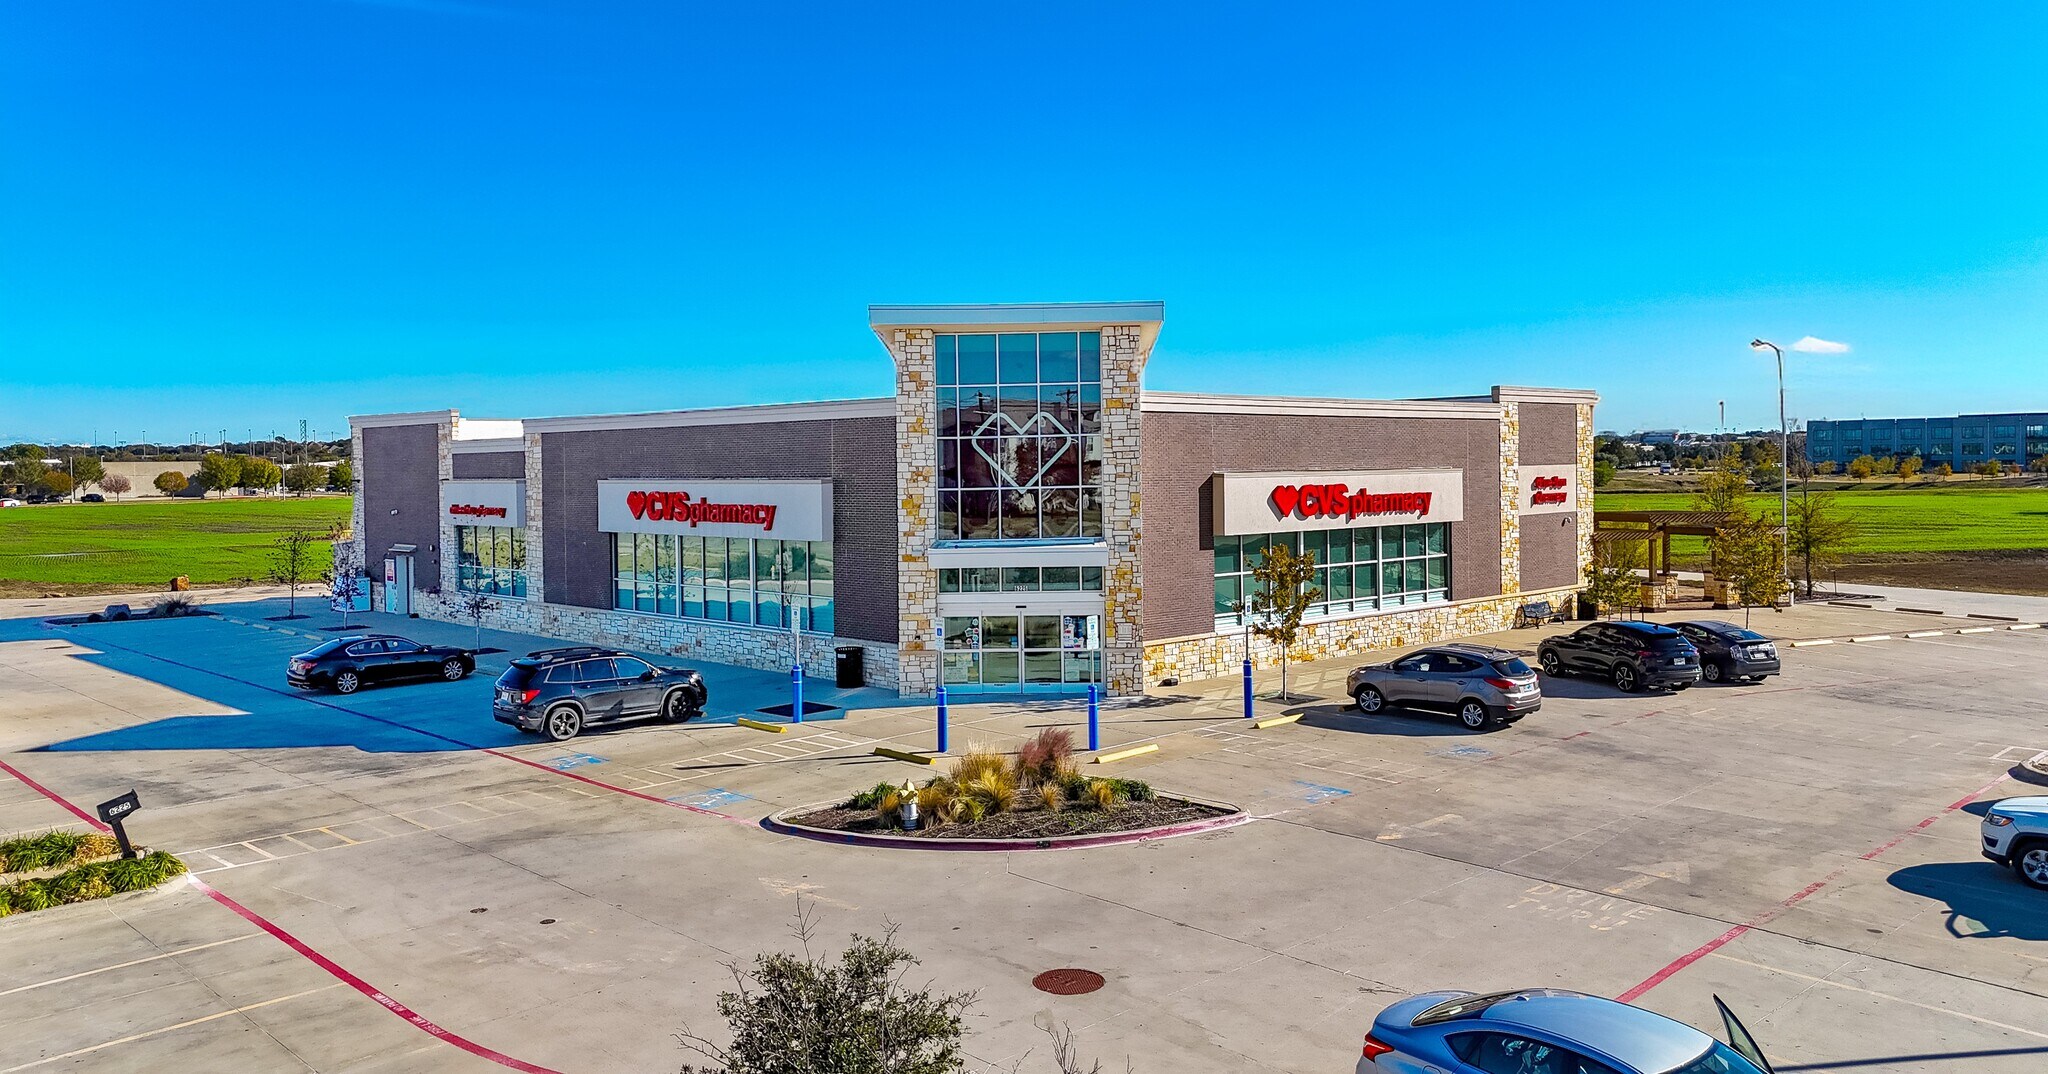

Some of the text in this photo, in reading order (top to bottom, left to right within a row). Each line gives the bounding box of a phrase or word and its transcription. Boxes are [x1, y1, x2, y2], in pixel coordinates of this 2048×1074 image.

[646, 491, 777, 531] CVS pharmacy
[1298, 484, 1432, 520] CVS pharmacy
[1525, 882, 1663, 920] DRIVE
